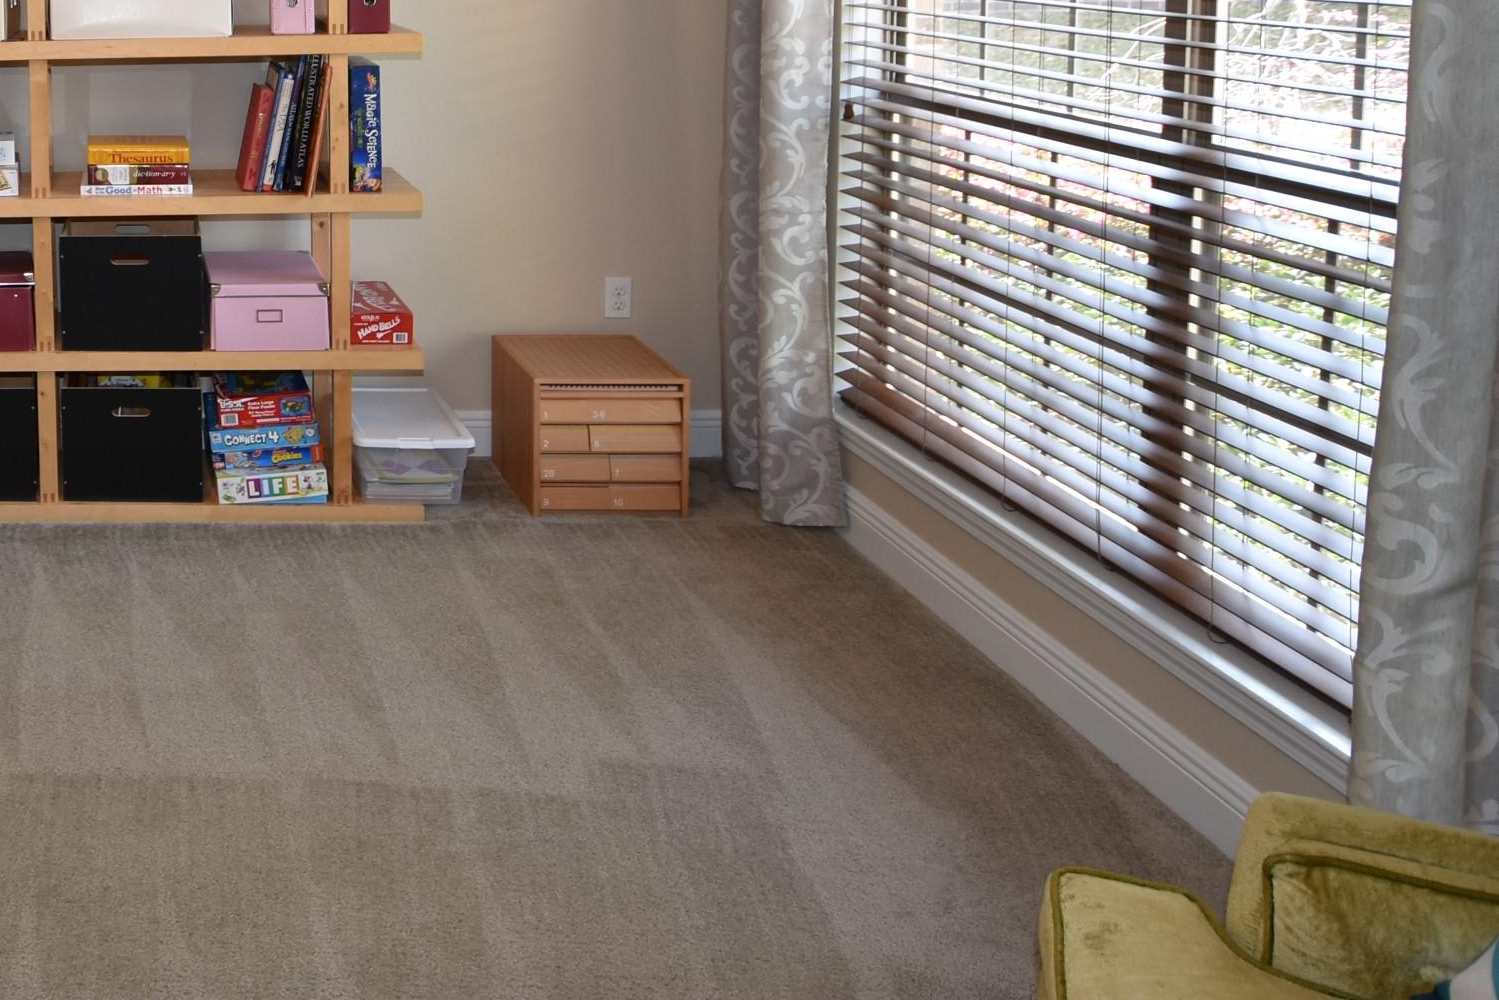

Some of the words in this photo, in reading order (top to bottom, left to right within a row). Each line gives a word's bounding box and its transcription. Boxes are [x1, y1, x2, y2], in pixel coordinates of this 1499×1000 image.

[306, 54, 319, 105] LLUSTRATED
[302, 107, 312, 140] WORLD
[109, 153, 173, 164] Thesaurus
[298, 141, 307, 168] ATLAS
[105, 186, 132, 195] Good
[137, 186, 162, 195] Math
[224, 434, 267, 446] CONNECT
[268, 431, 279, 444] 4
[247, 475, 298, 498] LIFE
